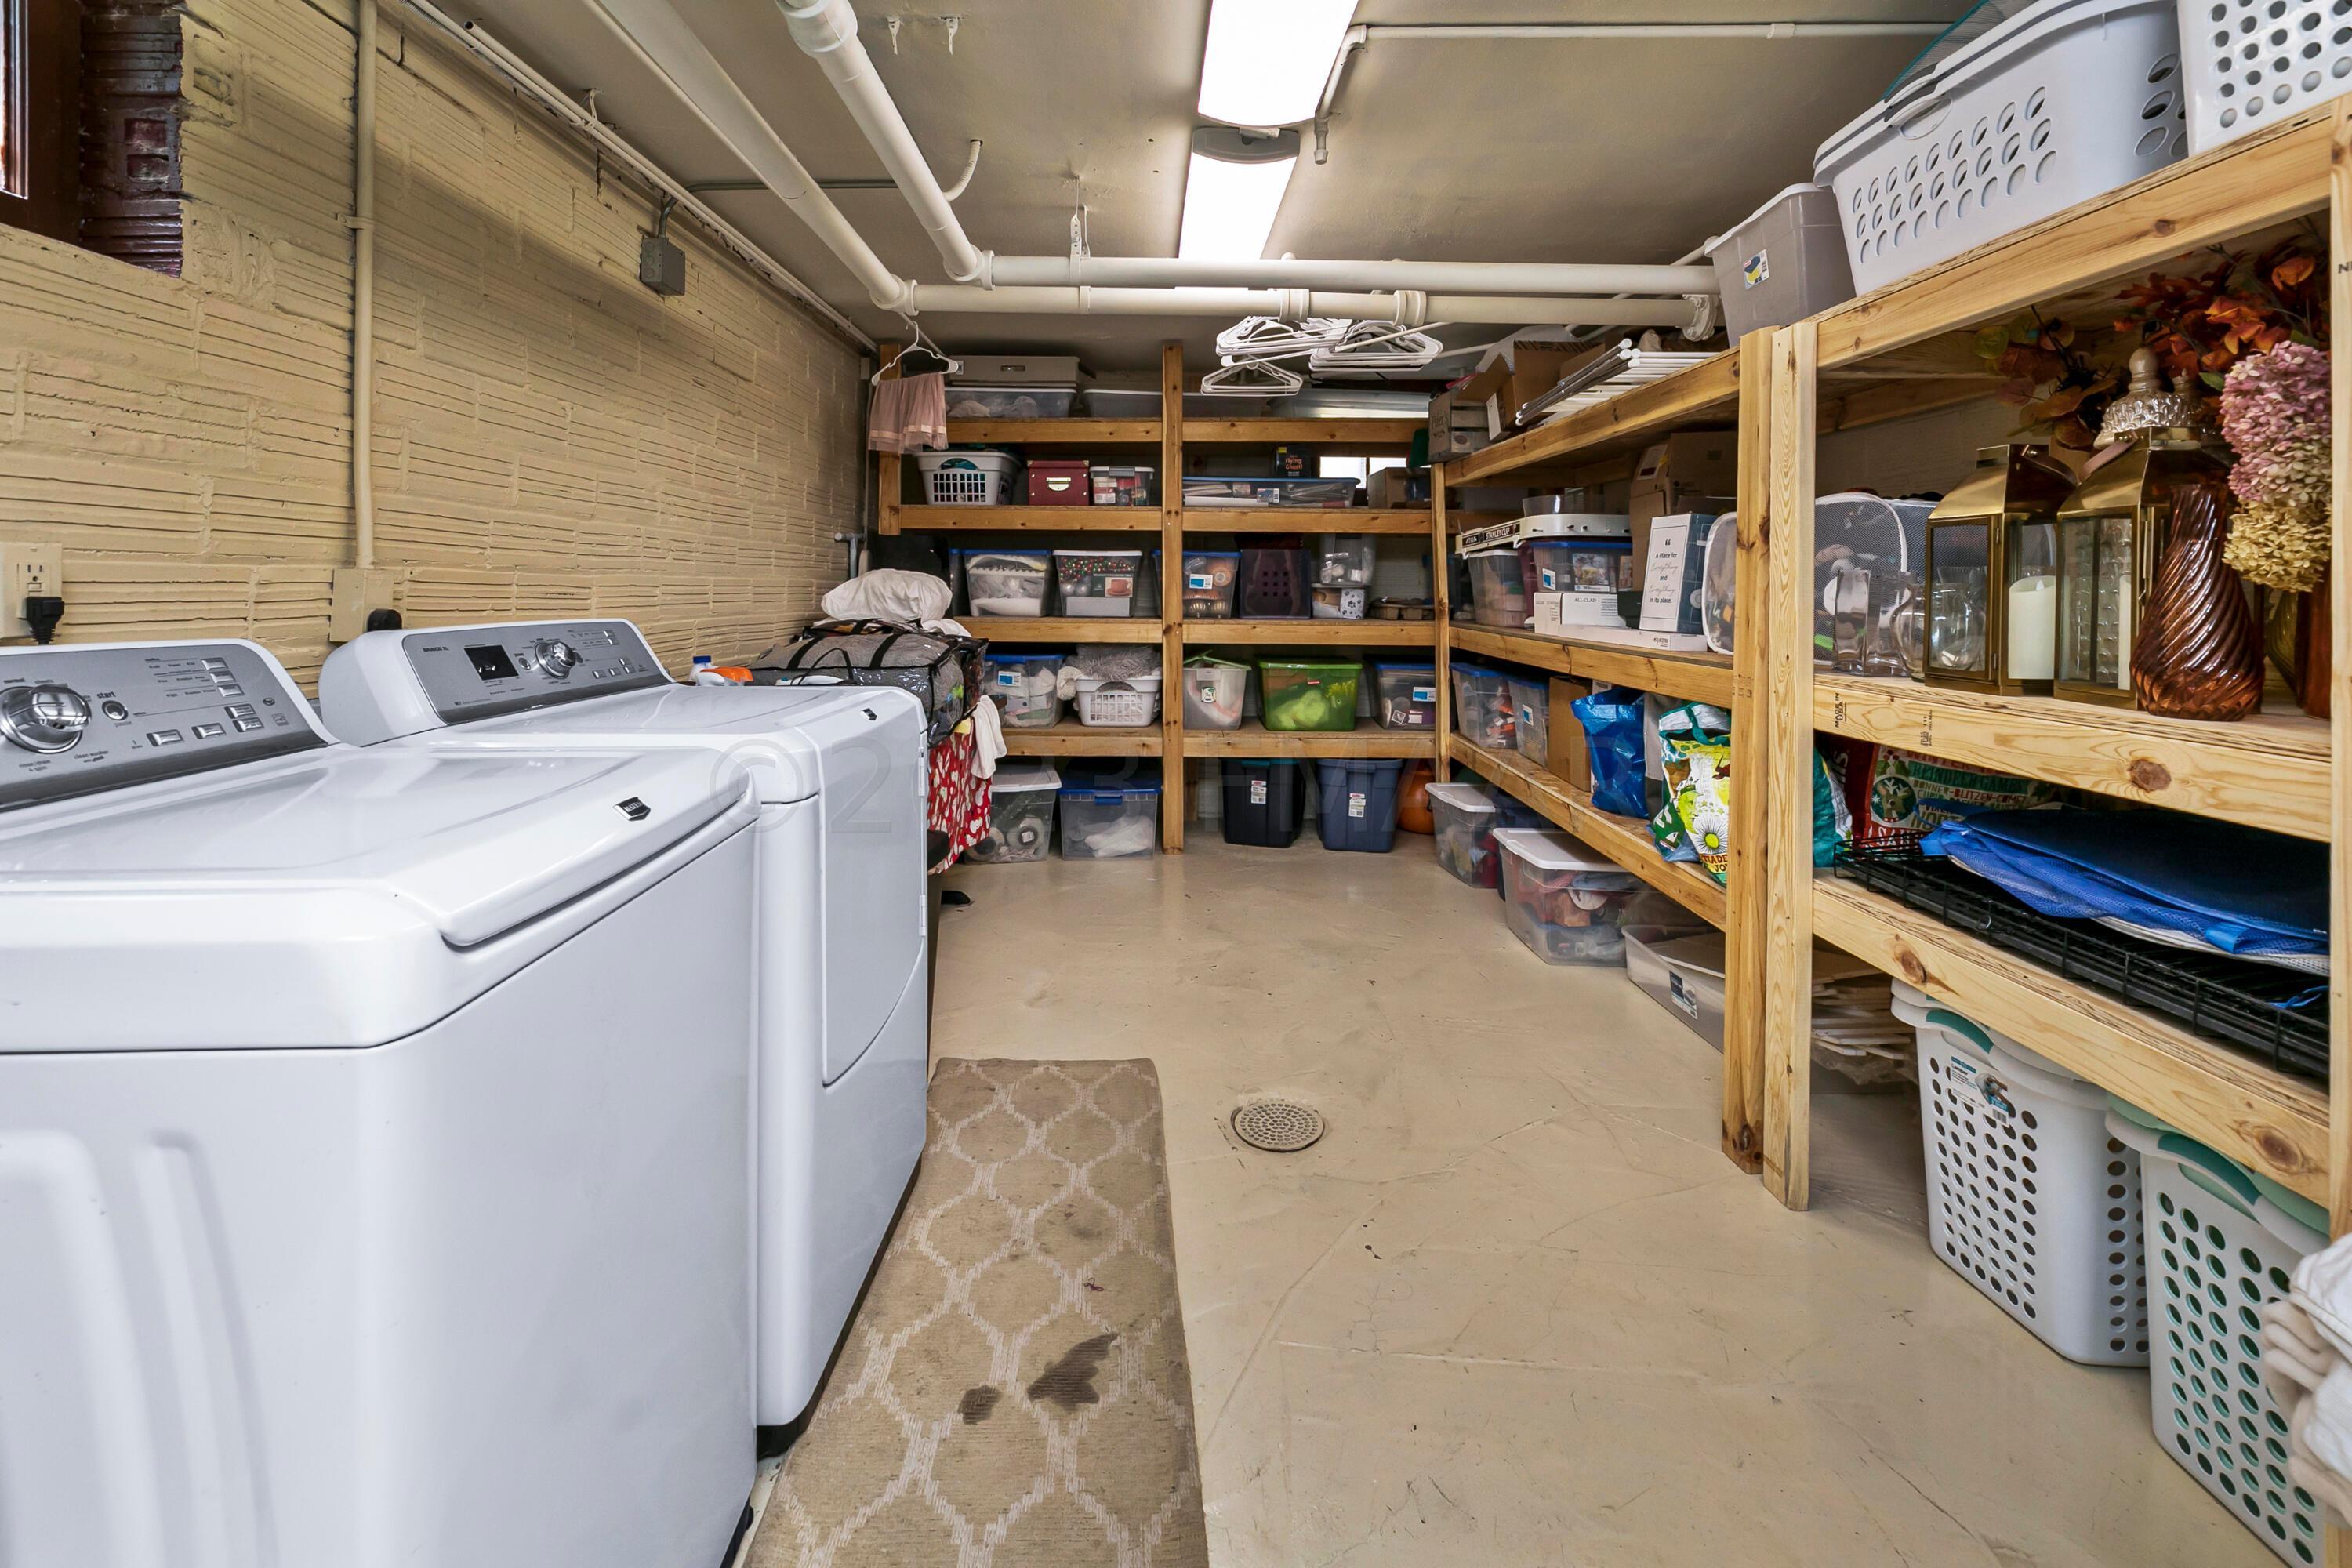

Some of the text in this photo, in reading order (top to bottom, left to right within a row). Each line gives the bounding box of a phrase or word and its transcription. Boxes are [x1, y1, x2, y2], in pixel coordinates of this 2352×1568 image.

[1486, 529, 1501, 540] STANLEY
[1501, 526, 1510, 536] CUP
[1700, 854, 1728, 864] TRADE
